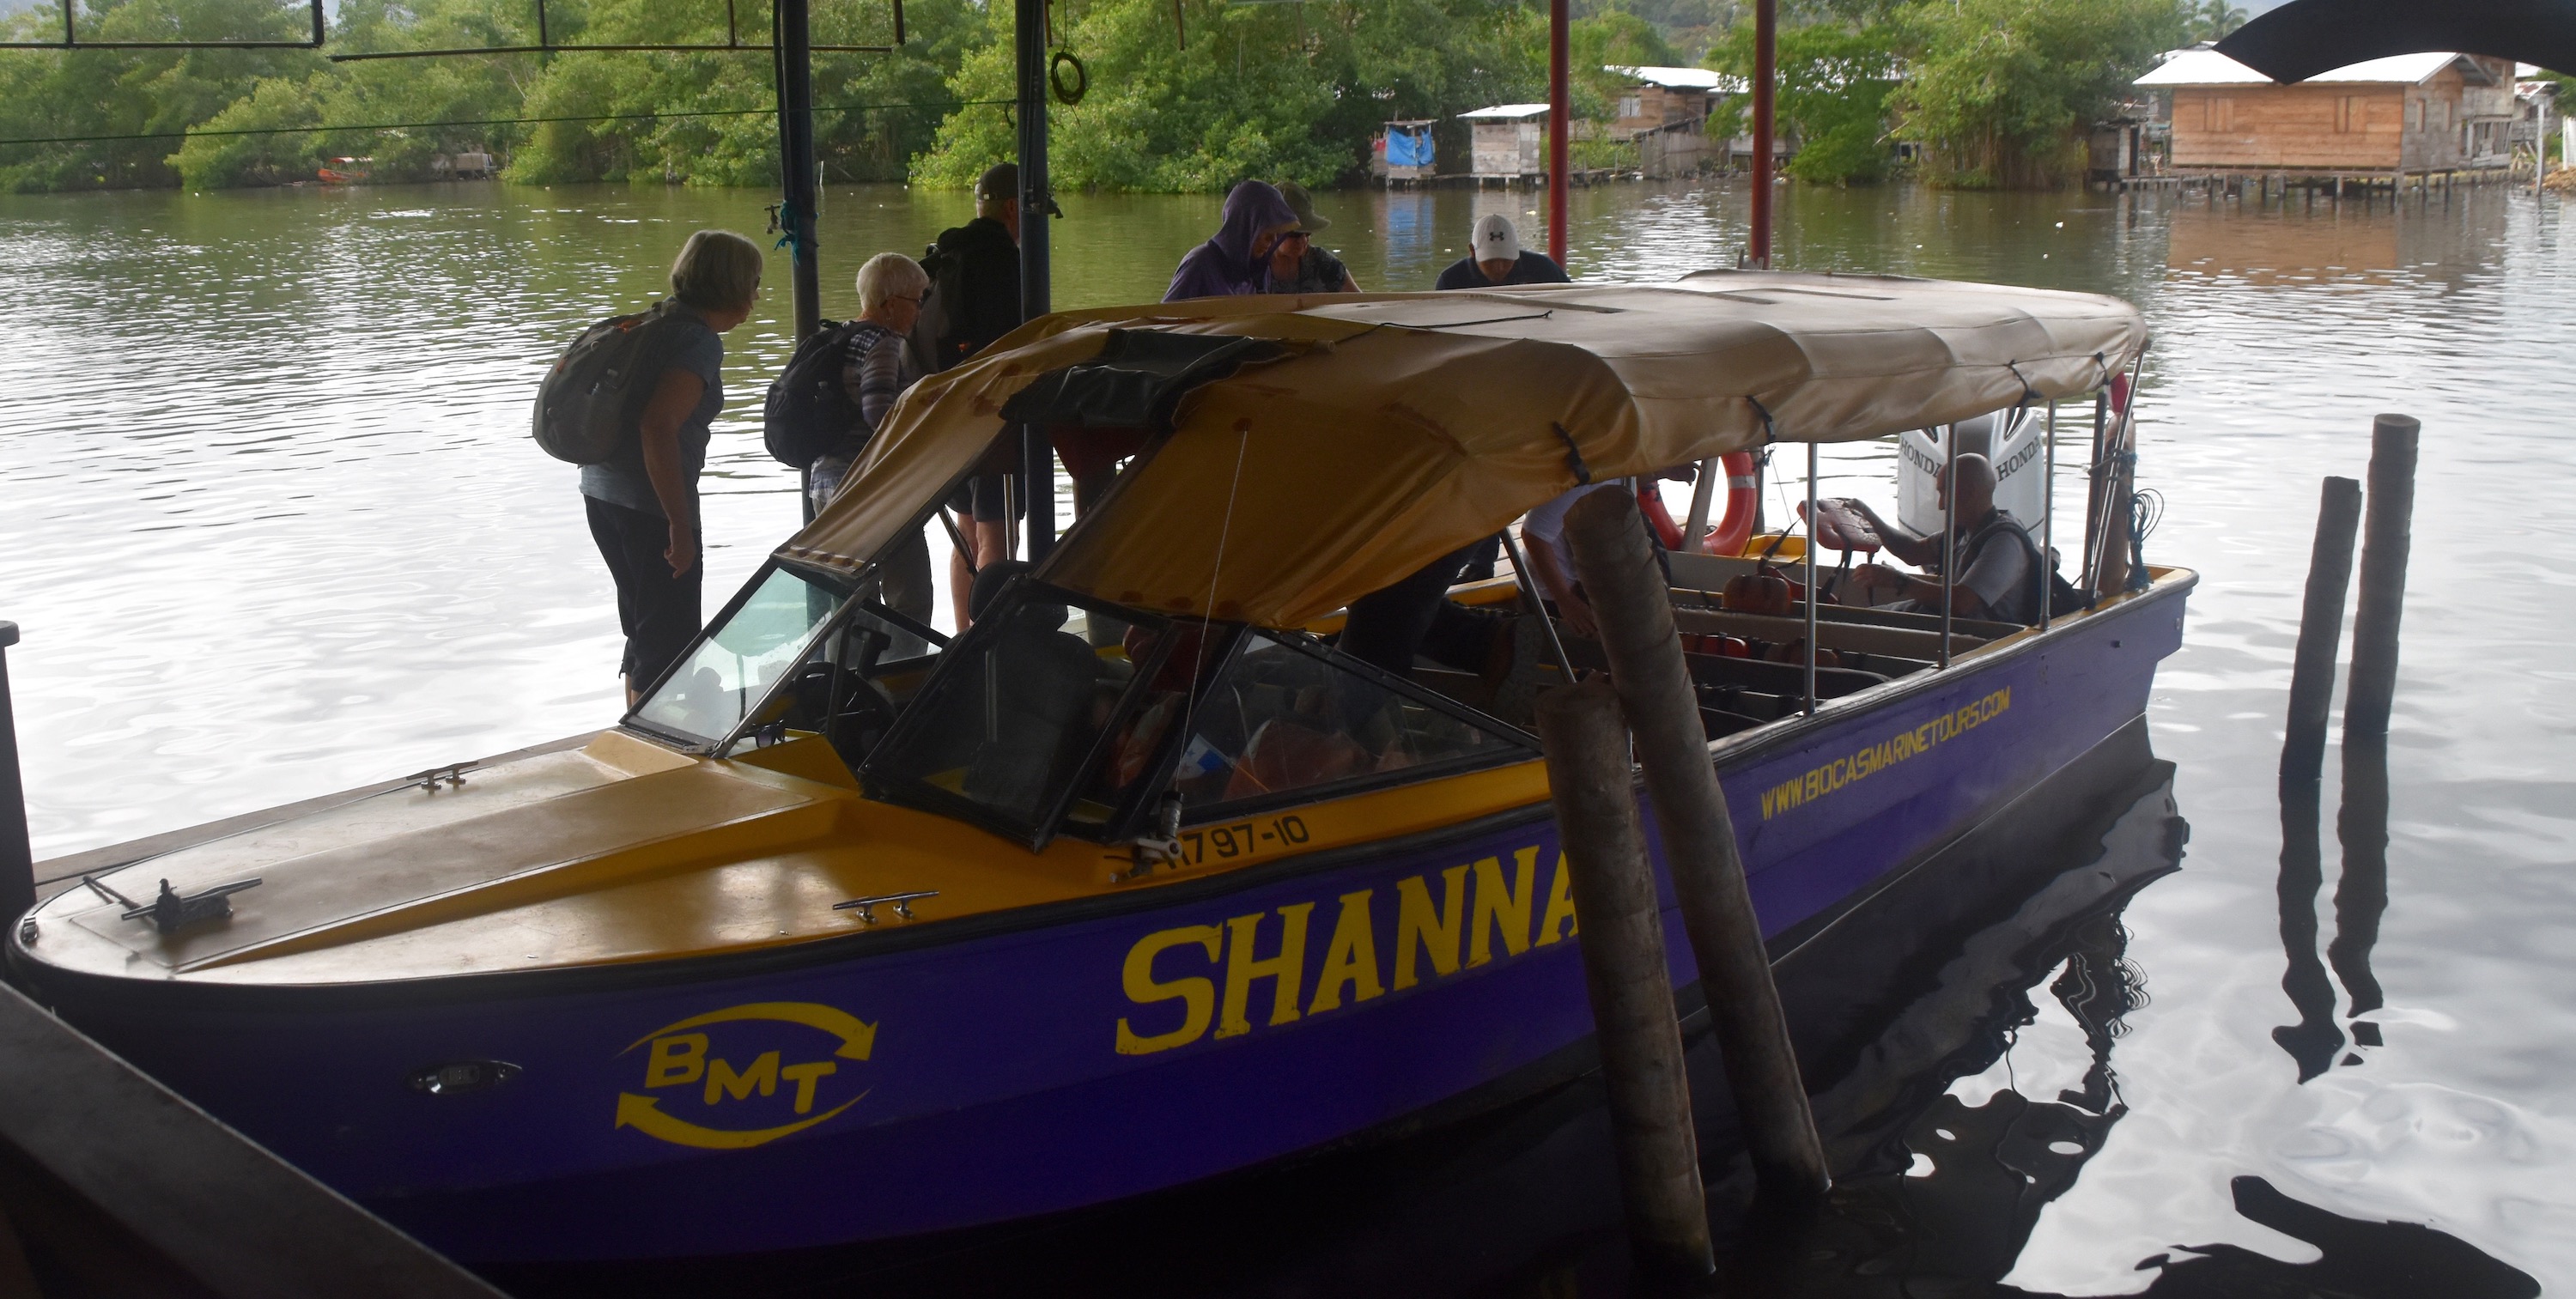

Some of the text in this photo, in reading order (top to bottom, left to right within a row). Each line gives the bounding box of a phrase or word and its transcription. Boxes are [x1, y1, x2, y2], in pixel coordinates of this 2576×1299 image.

[1996, 435, 2041, 483] HONDA
[1761, 685, 2011, 821] WWW.BOCASMARINETOURS.COM
[645, 1032, 836, 1114] BMT
